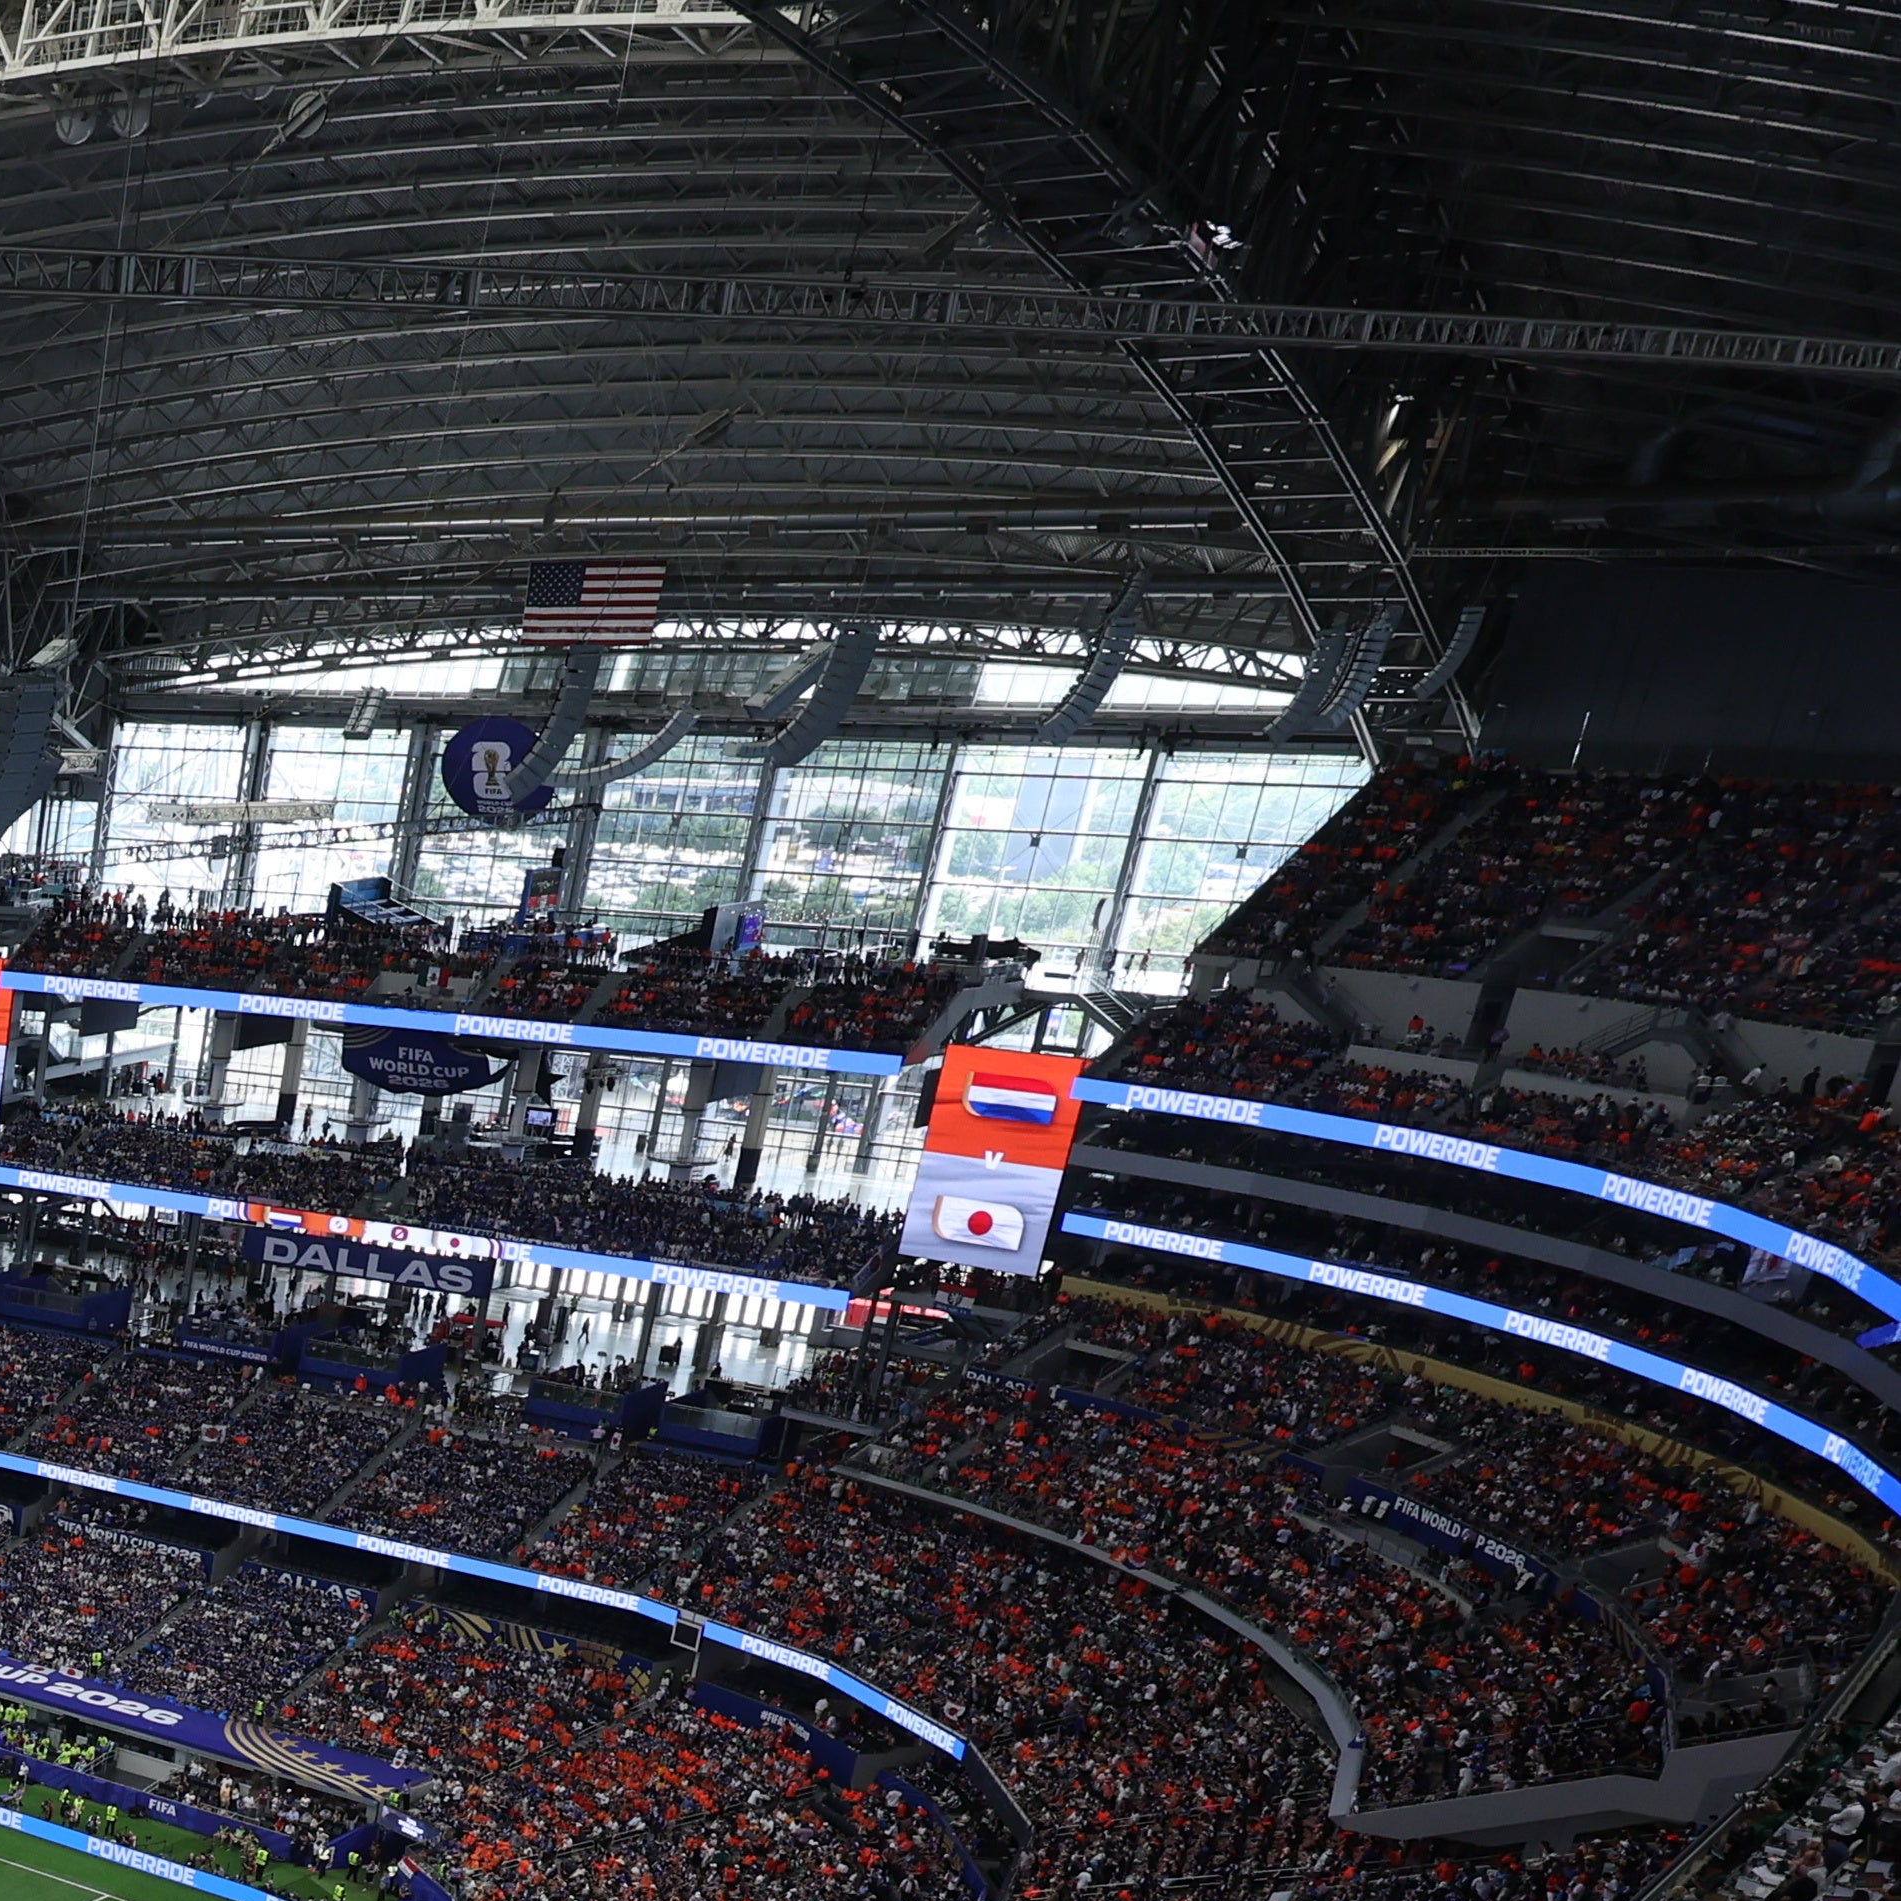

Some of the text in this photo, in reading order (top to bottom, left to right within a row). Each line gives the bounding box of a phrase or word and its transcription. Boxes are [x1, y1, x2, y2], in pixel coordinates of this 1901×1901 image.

[239, 995, 345, 1022] POWERADE
[368, 1056, 469, 1079] WORLD CUP
[398, 1046, 435, 1064] FIFA
[697, 1038, 830, 1068] POWERADE
[388, 1074, 439, 1089] 2026
[1126, 1086, 1263, 1124] POWERADE
[18, 1171, 110, 1199] POWERADE
[1104, 1221, 1224, 1260] POWERADE
[264, 1238, 473, 1293] DALLAS
[651, 1262, 779, 1299] POWERADE
[1309, 1262, 1427, 1305] POWERADE
[182, 1340, 198, 1349] FIFA
[226, 1346, 241, 1357] CUP
[38, 1463, 117, 1492] POWERADE
[1394, 1496, 1422, 1521] FIFA
[1418, 1507, 1462, 1540] WORLD
[1483, 1535, 1526, 1569] 2026
[357, 1534, 450, 1568] POWERADE
[44, 1681, 183, 1726] 2026
[886, 1701, 955, 1753] POWERADE
[149, 1798, 176, 1817] FIFA
